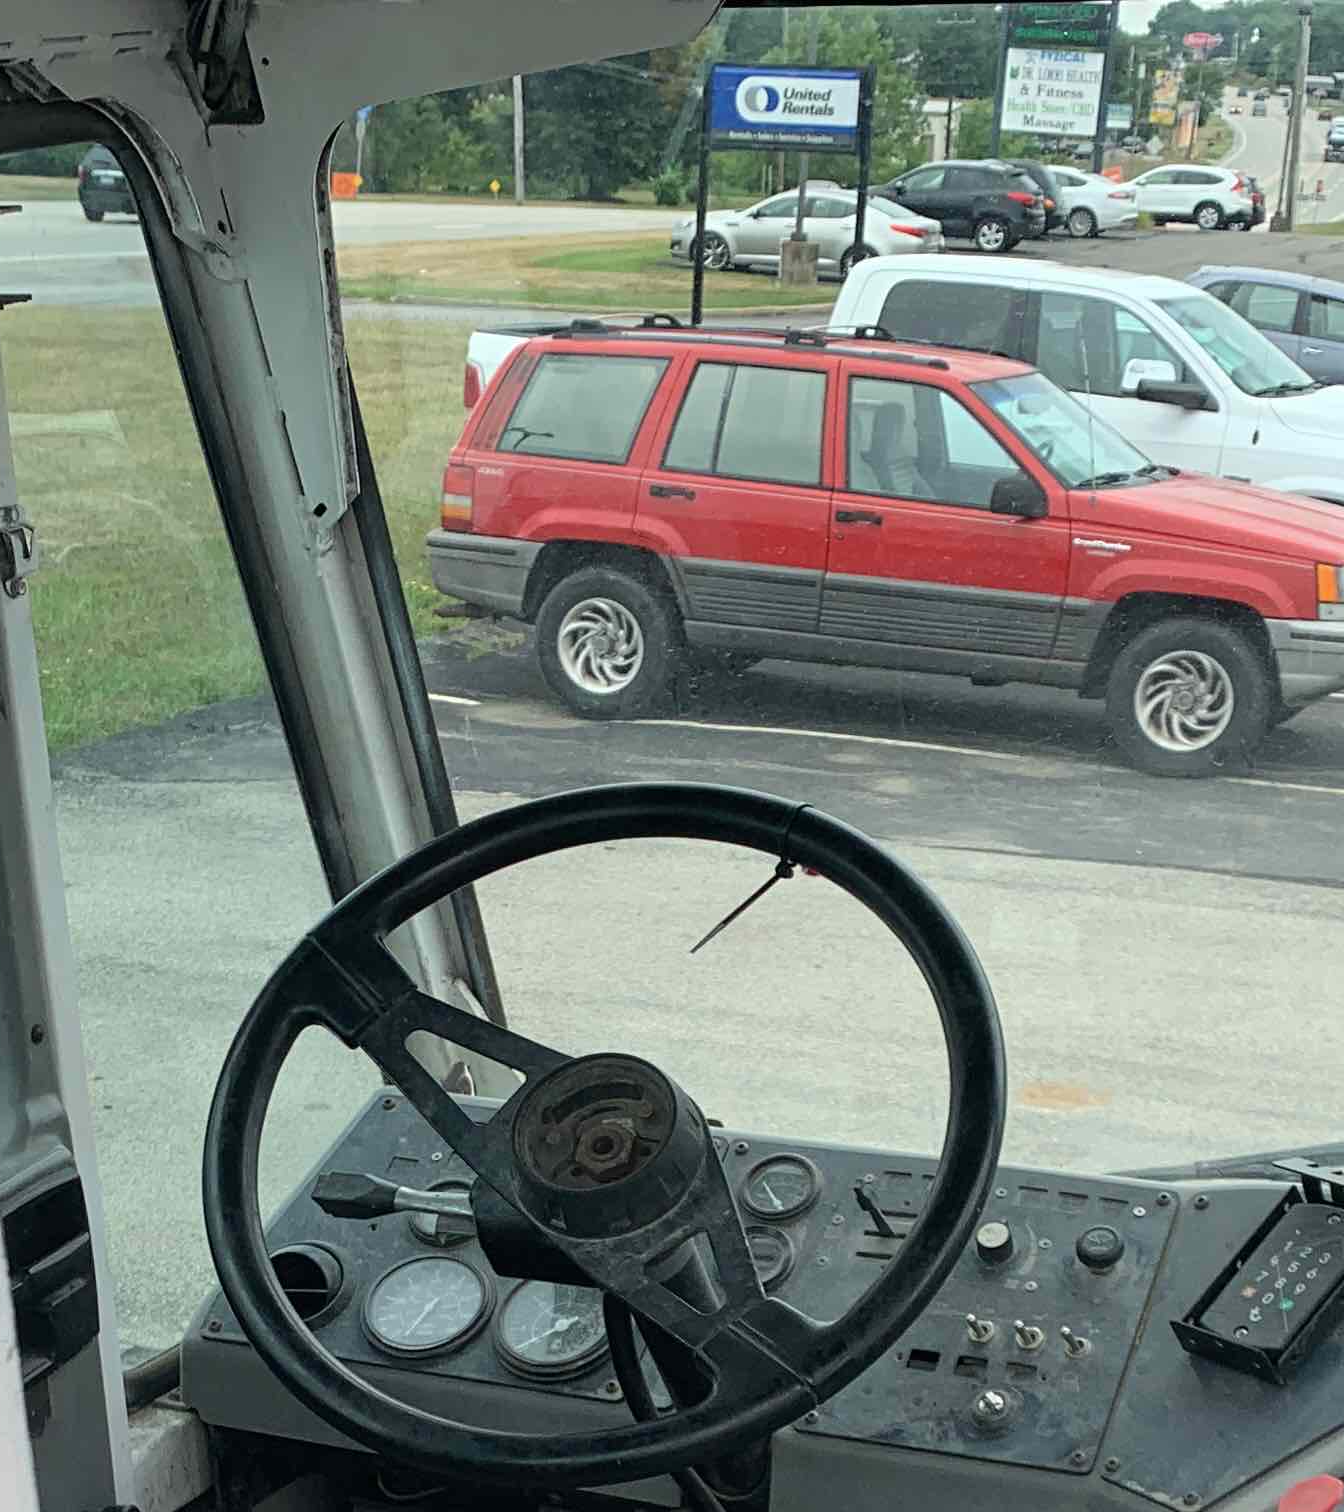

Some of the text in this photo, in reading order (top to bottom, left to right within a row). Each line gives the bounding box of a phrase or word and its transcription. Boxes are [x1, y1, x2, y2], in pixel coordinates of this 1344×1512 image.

[783, 87, 833, 102] United
[1037, 83, 1084, 99] Fitness
[782, 102, 835, 117] Rentals
[1023, 114, 1077, 132] Massage
[1299, 1246, 1313, 1259] 2
[1318, 1252, 1332, 1265] 3
[1287, 1261, 1301, 1273] 5
[1306, 1267, 1318, 1280] 6
[1256, 1269, 1270, 1282] 7
[1293, 1282, 1307, 1295] 9
[1261, 1292, 1275, 1305] 0
